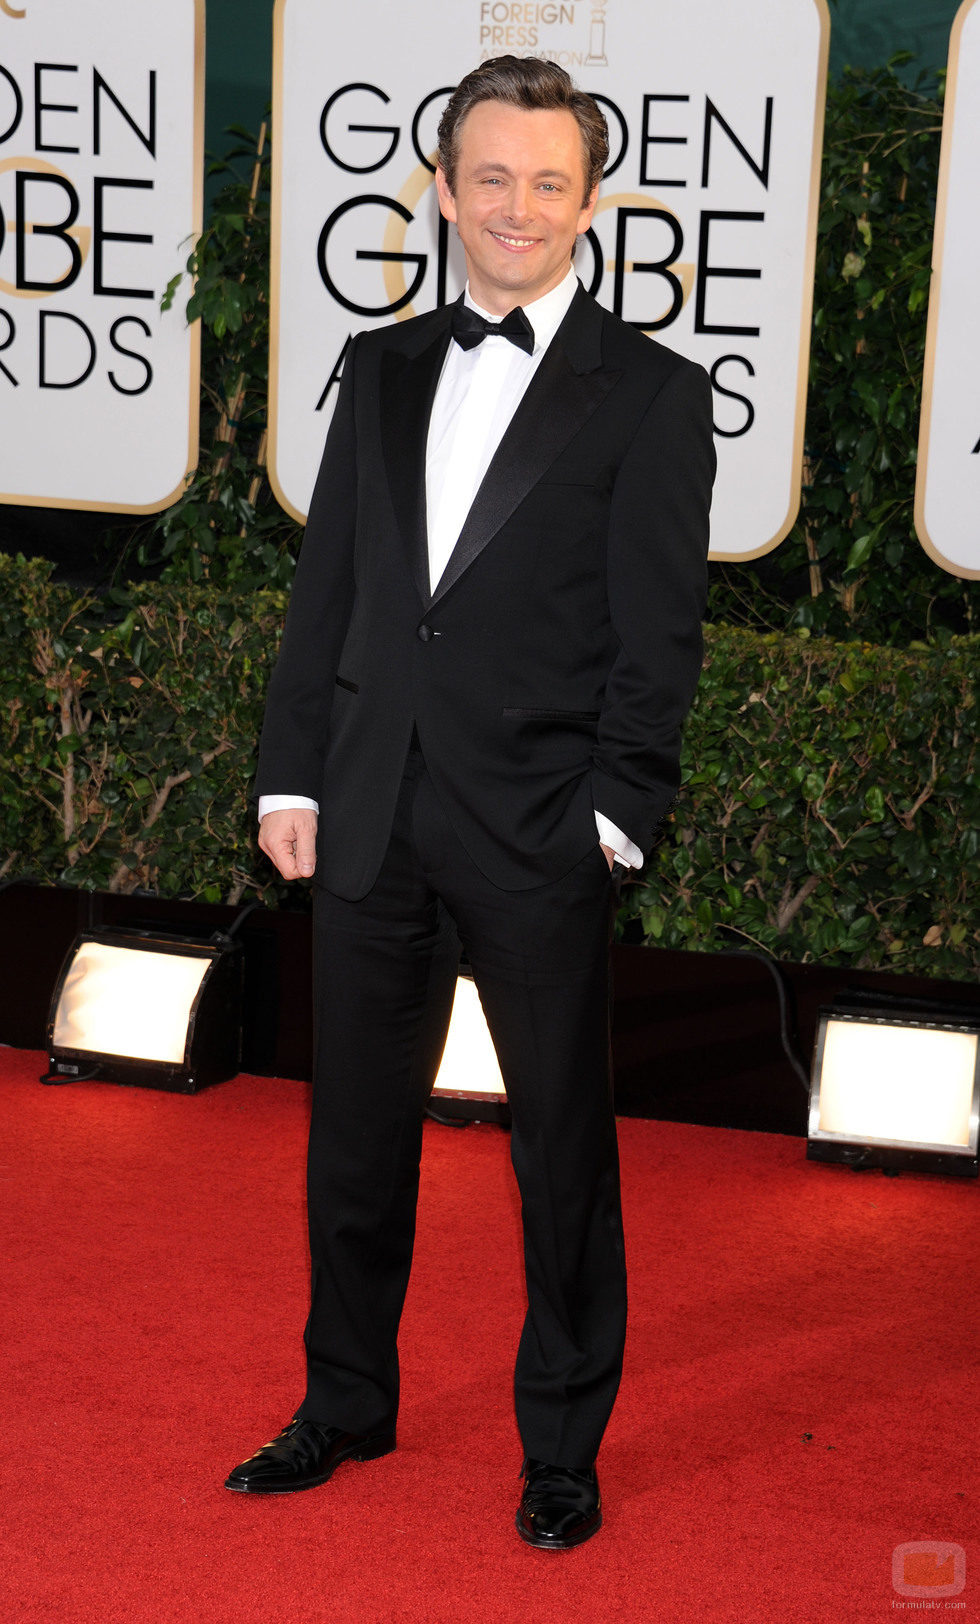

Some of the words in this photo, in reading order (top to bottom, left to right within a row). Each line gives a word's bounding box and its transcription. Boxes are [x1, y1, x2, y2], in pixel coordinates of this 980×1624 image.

[480, 2, 575, 25] FOREIGN
[480, 25, 538, 46] PRESS
[0, 171, 154, 299] BE
